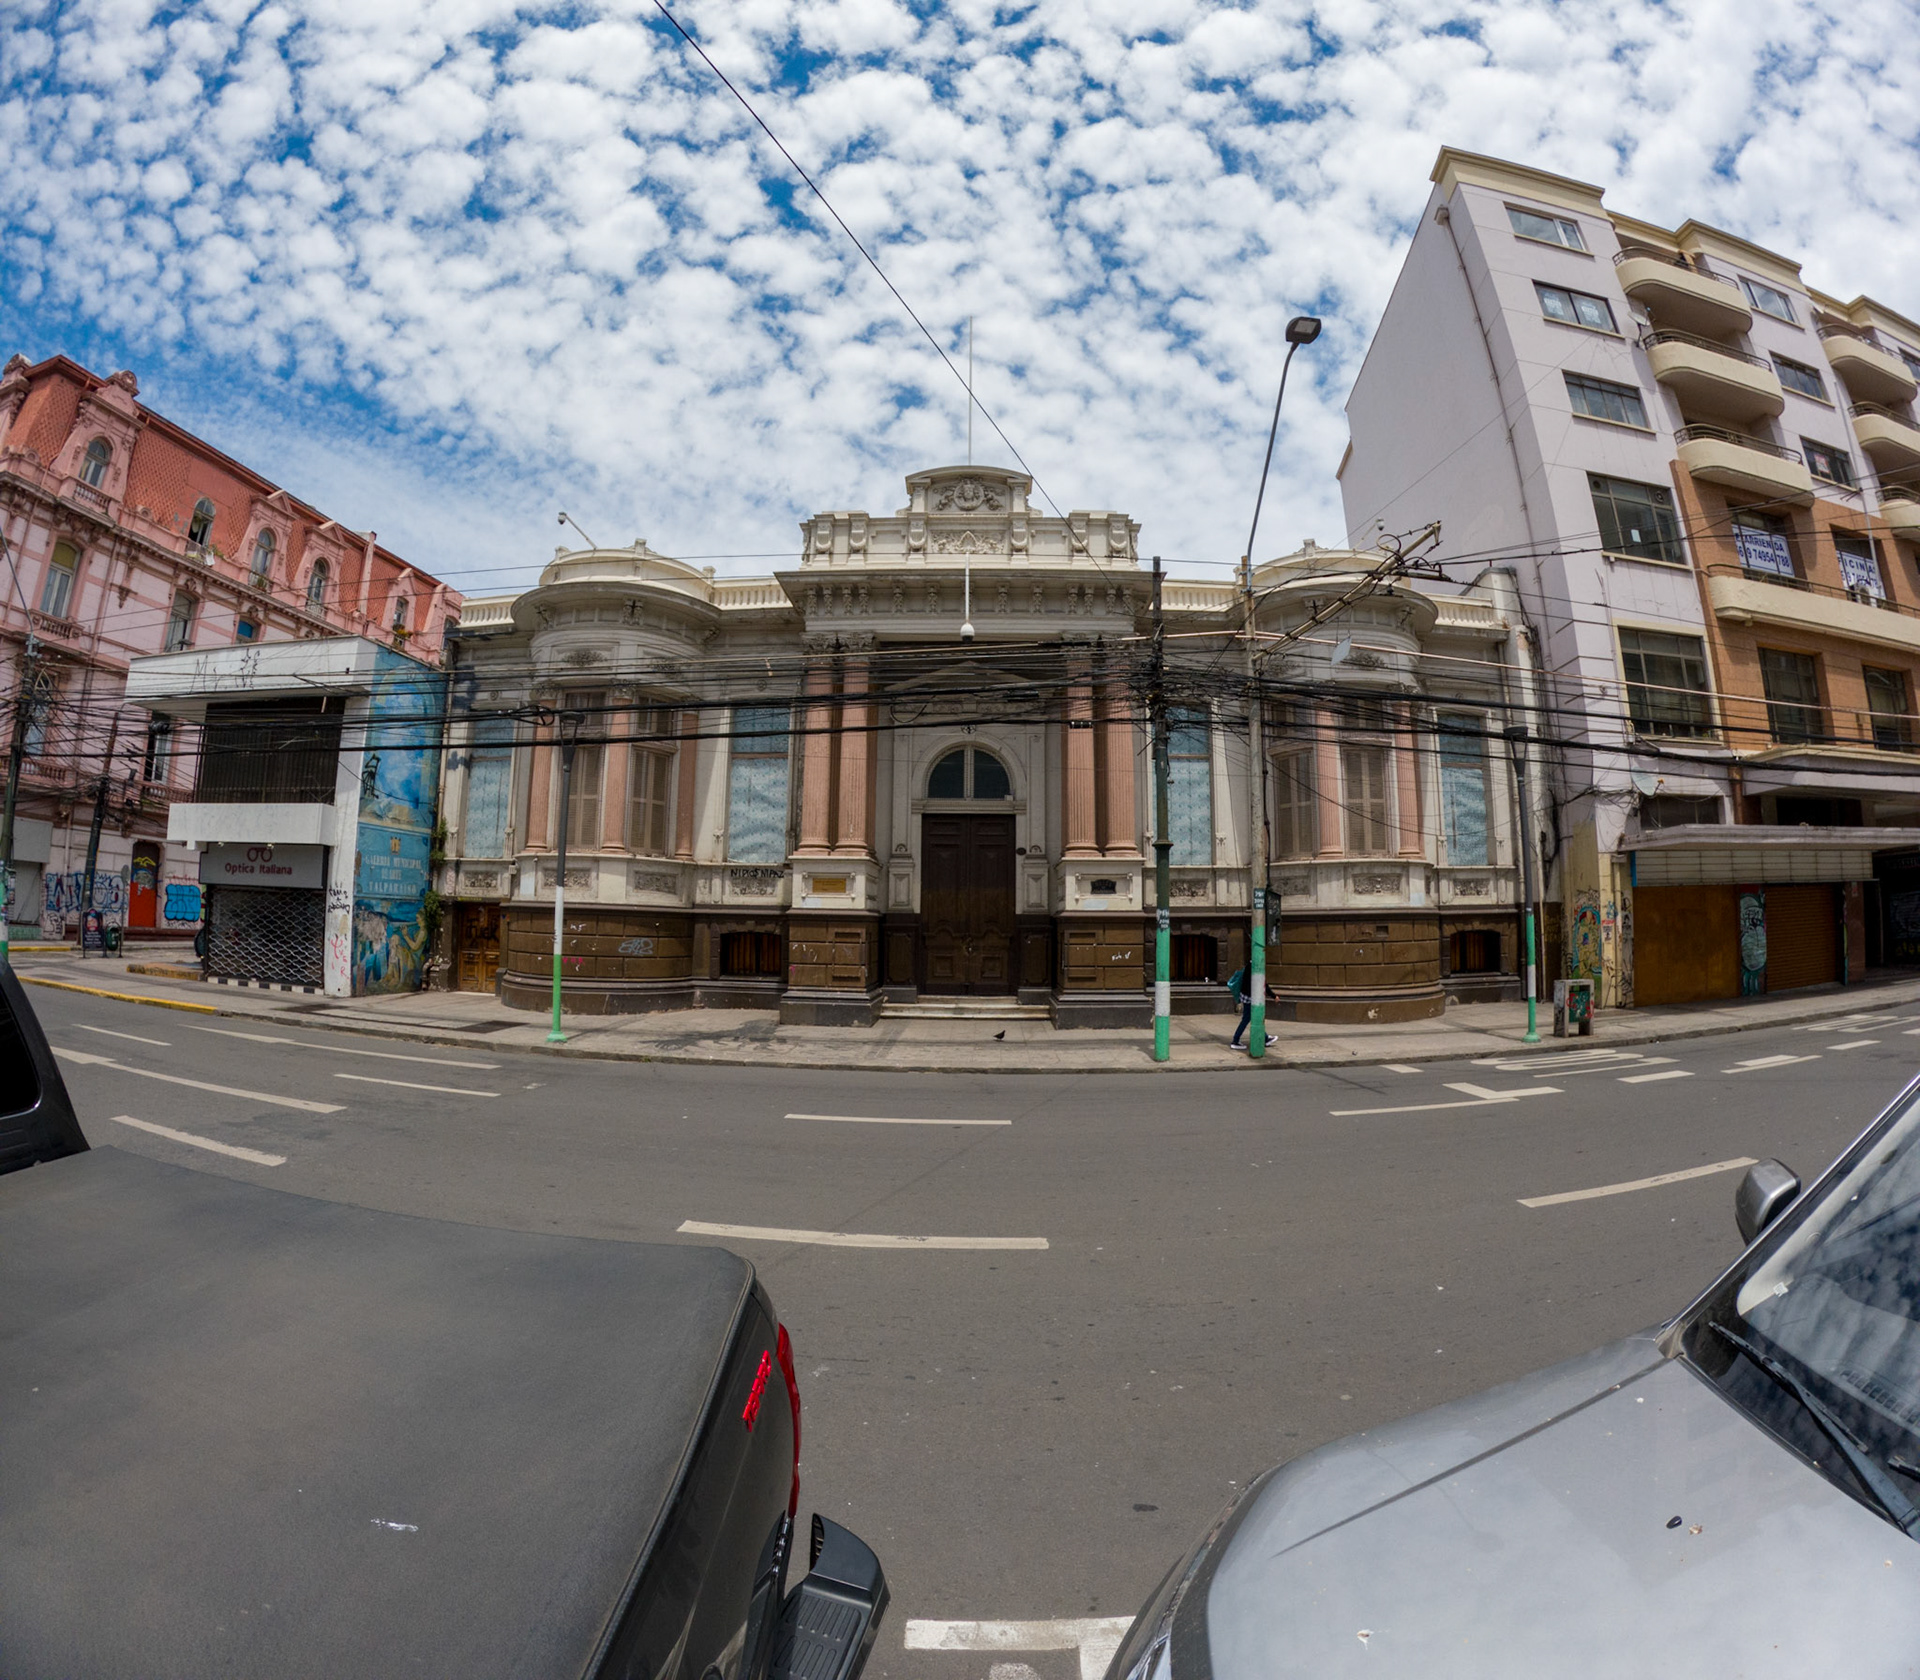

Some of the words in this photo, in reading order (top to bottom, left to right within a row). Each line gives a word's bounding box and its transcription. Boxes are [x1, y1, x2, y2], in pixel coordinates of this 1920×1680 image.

[1744, 535, 1785, 552] ARRIENDA
[224, 863, 254, 875] Optica
[259, 864, 293, 875] Italiana
[365, 855, 390, 867] GALERIA
[393, 857, 422, 869] MUNICIPAL
